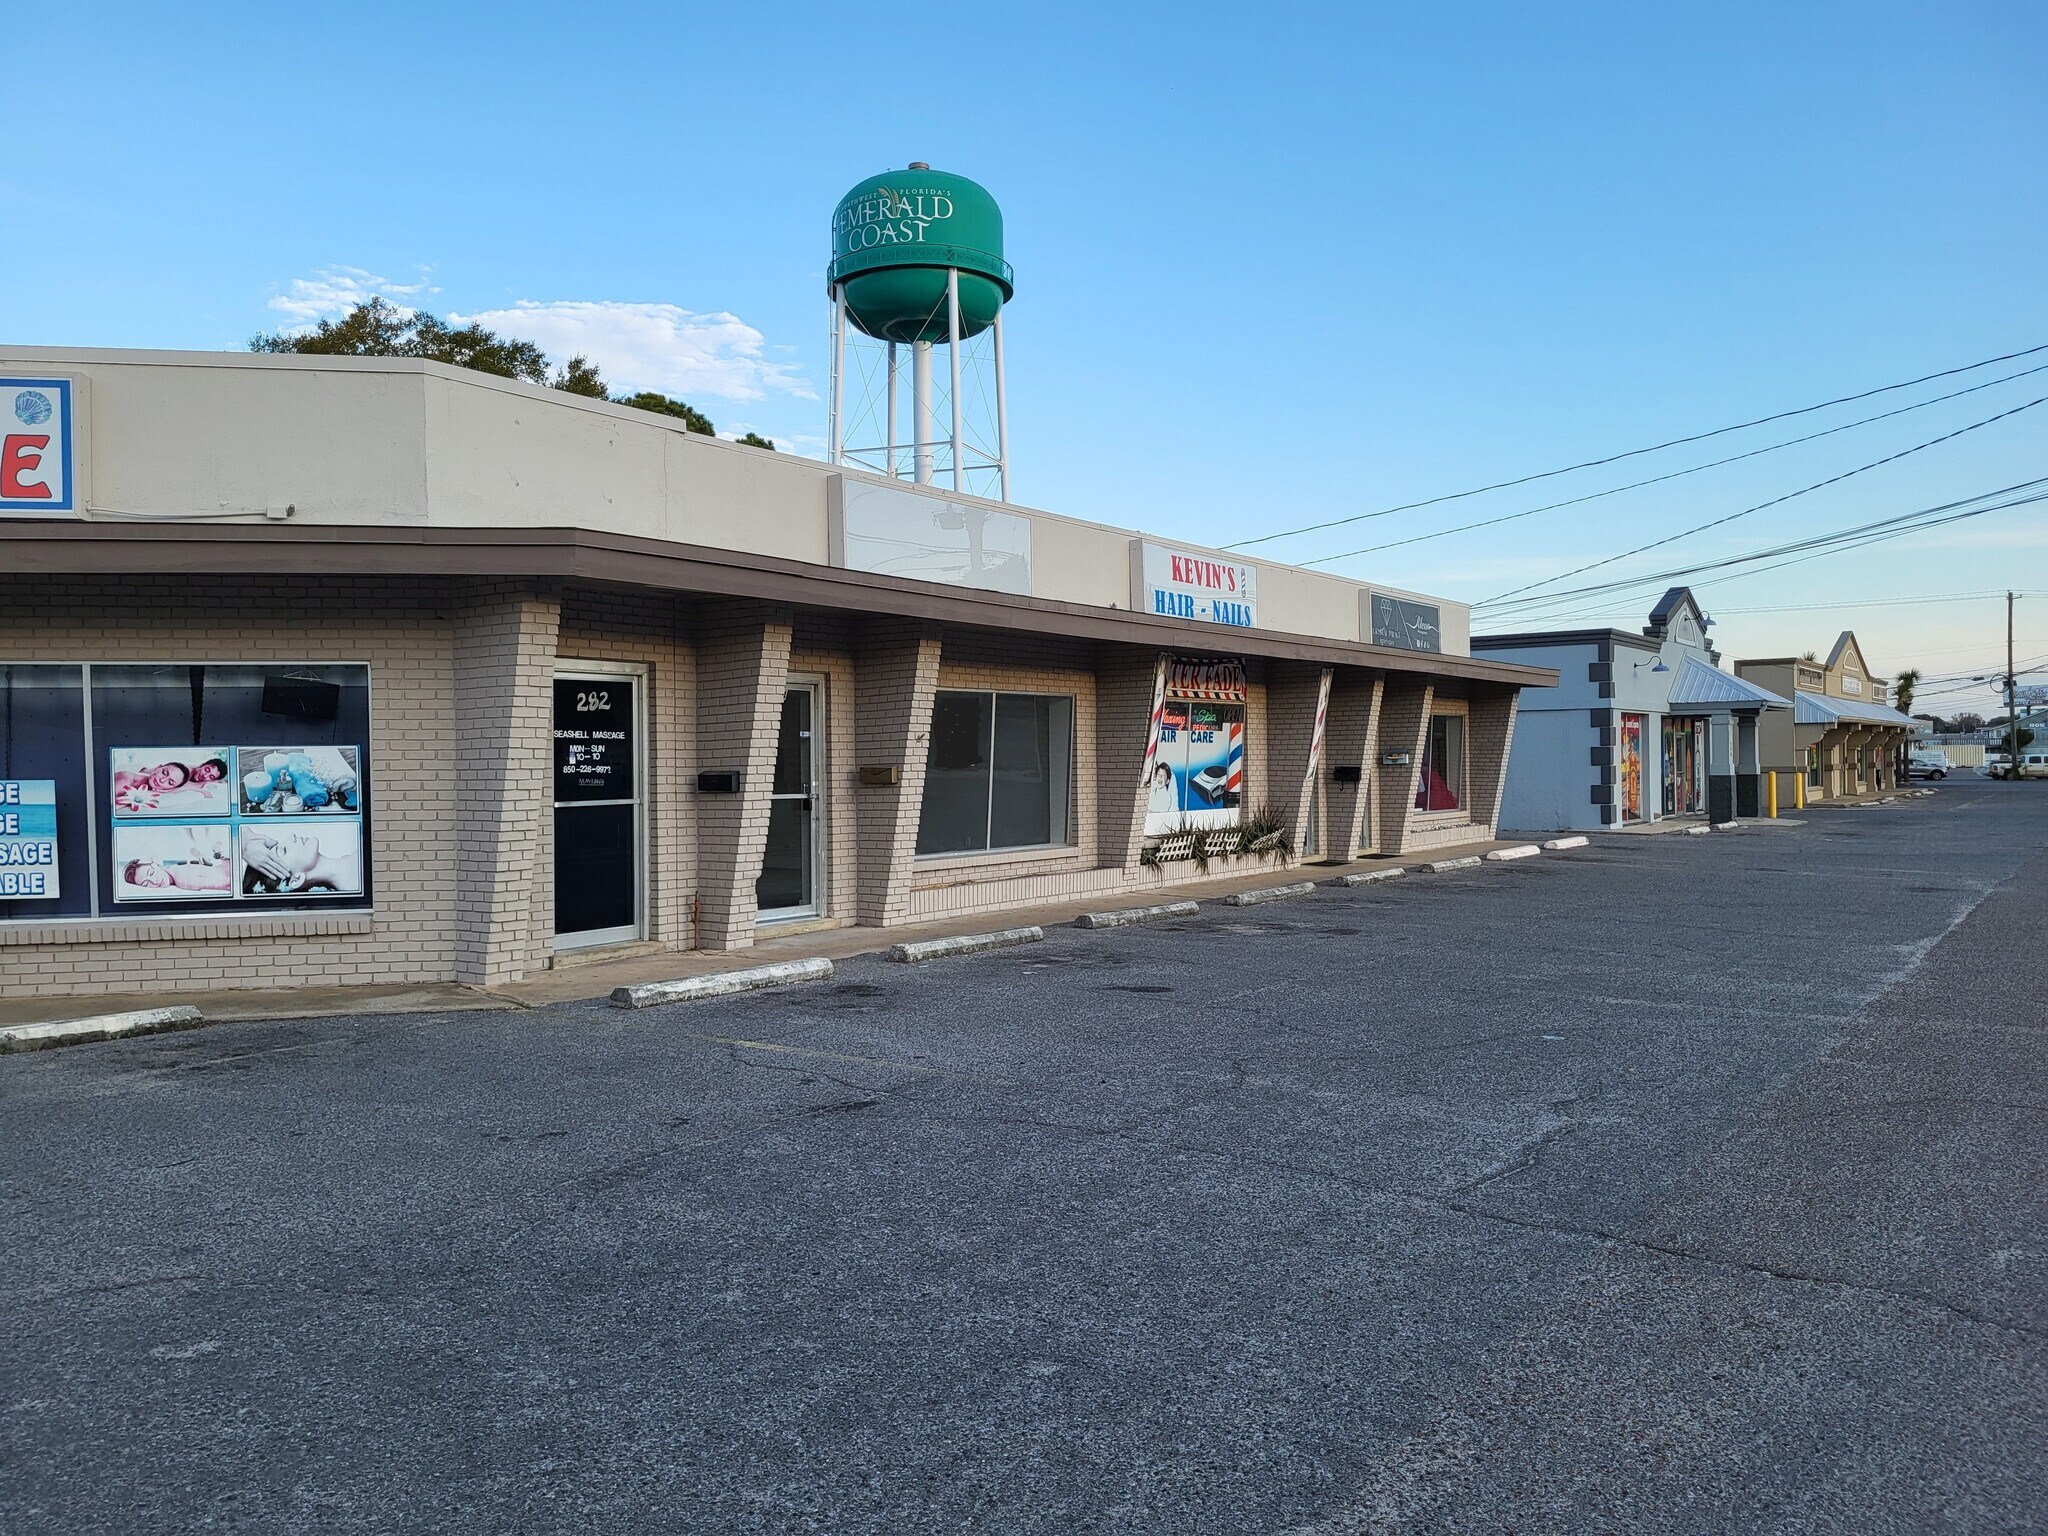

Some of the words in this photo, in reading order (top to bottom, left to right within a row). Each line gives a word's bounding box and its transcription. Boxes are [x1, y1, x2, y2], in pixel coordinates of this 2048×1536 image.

[900, 188, 951, 196] FLORIDA'S
[840, 196, 954, 236] EMERALD
[848, 219, 931, 252] COAST
[0, 433, 52, 498] E
[1170, 554, 1236, 592] KEVIN'S
[1154, 589, 1194, 618] HAIR
[1212, 599, 1251, 627] NAILS
[1169, 661, 1200, 690] TER
[1204, 664, 1241, 693] FADE
[576, 691, 611, 712] 282
[1196, 709, 1217, 725] Spa
[553, 730, 590, 739] SEASHELL
[592, 730, 626, 740] MASSAGE
[1160, 730, 1177, 744] AIR
[1190, 731, 1214, 744] CARE
